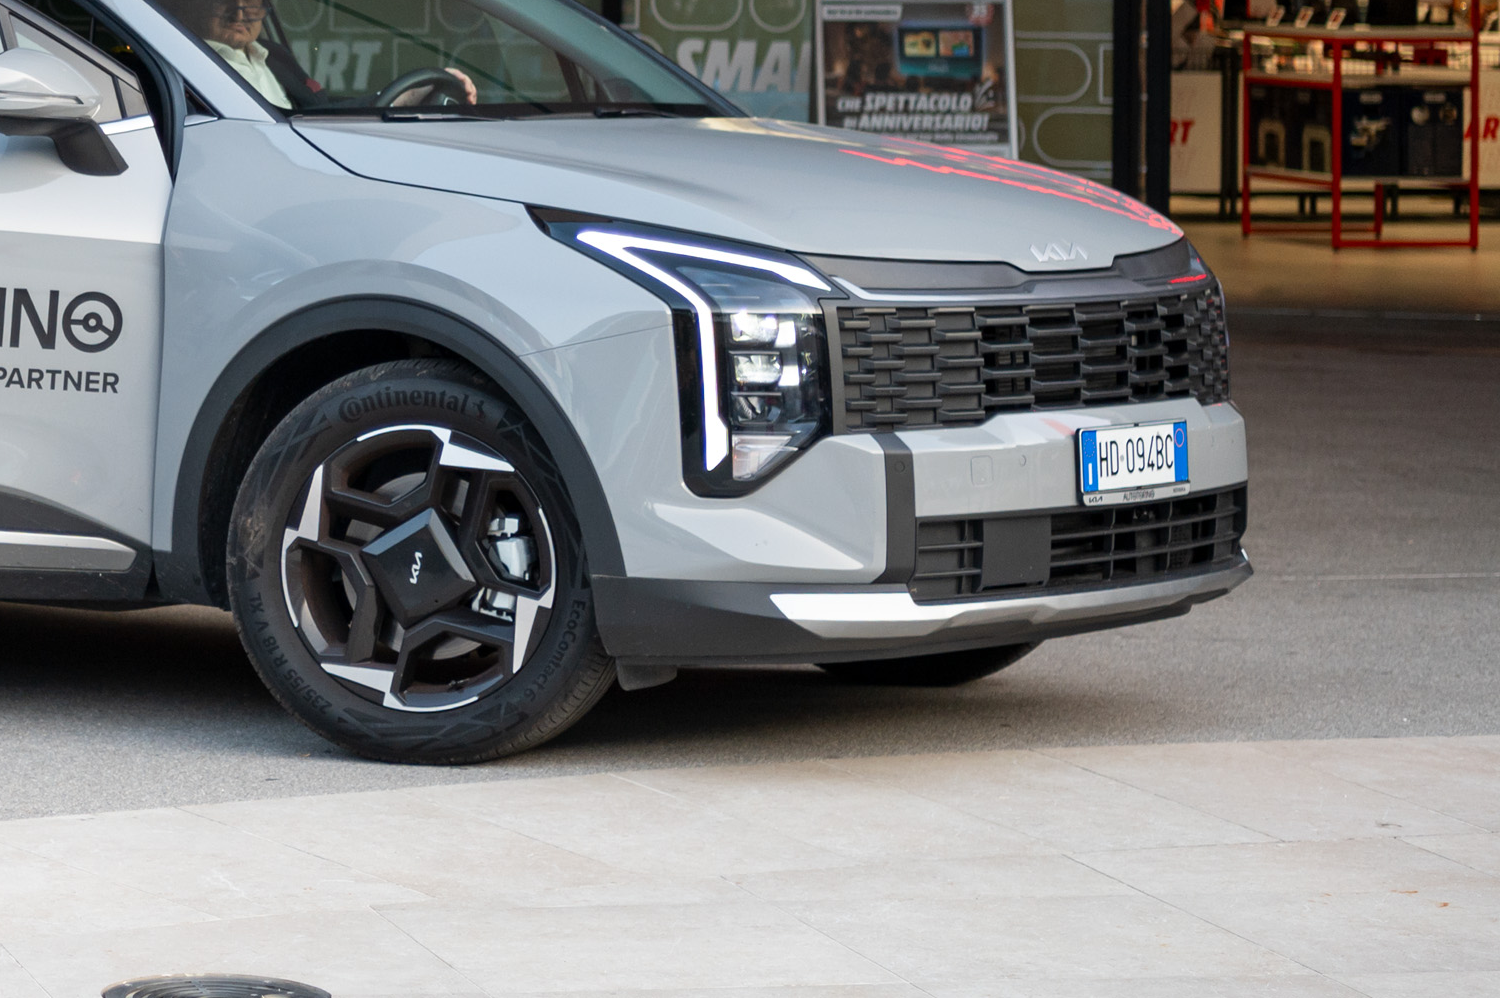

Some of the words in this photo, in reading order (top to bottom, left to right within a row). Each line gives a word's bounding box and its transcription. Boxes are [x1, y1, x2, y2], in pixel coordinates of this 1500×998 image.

[864, 91, 973, 113] SPETTACOLO
[858, 113, 990, 132] ANNIVERSARIO!
[338, 386, 470, 423] Continental
[534, 599, 586, 691] EcoContact
